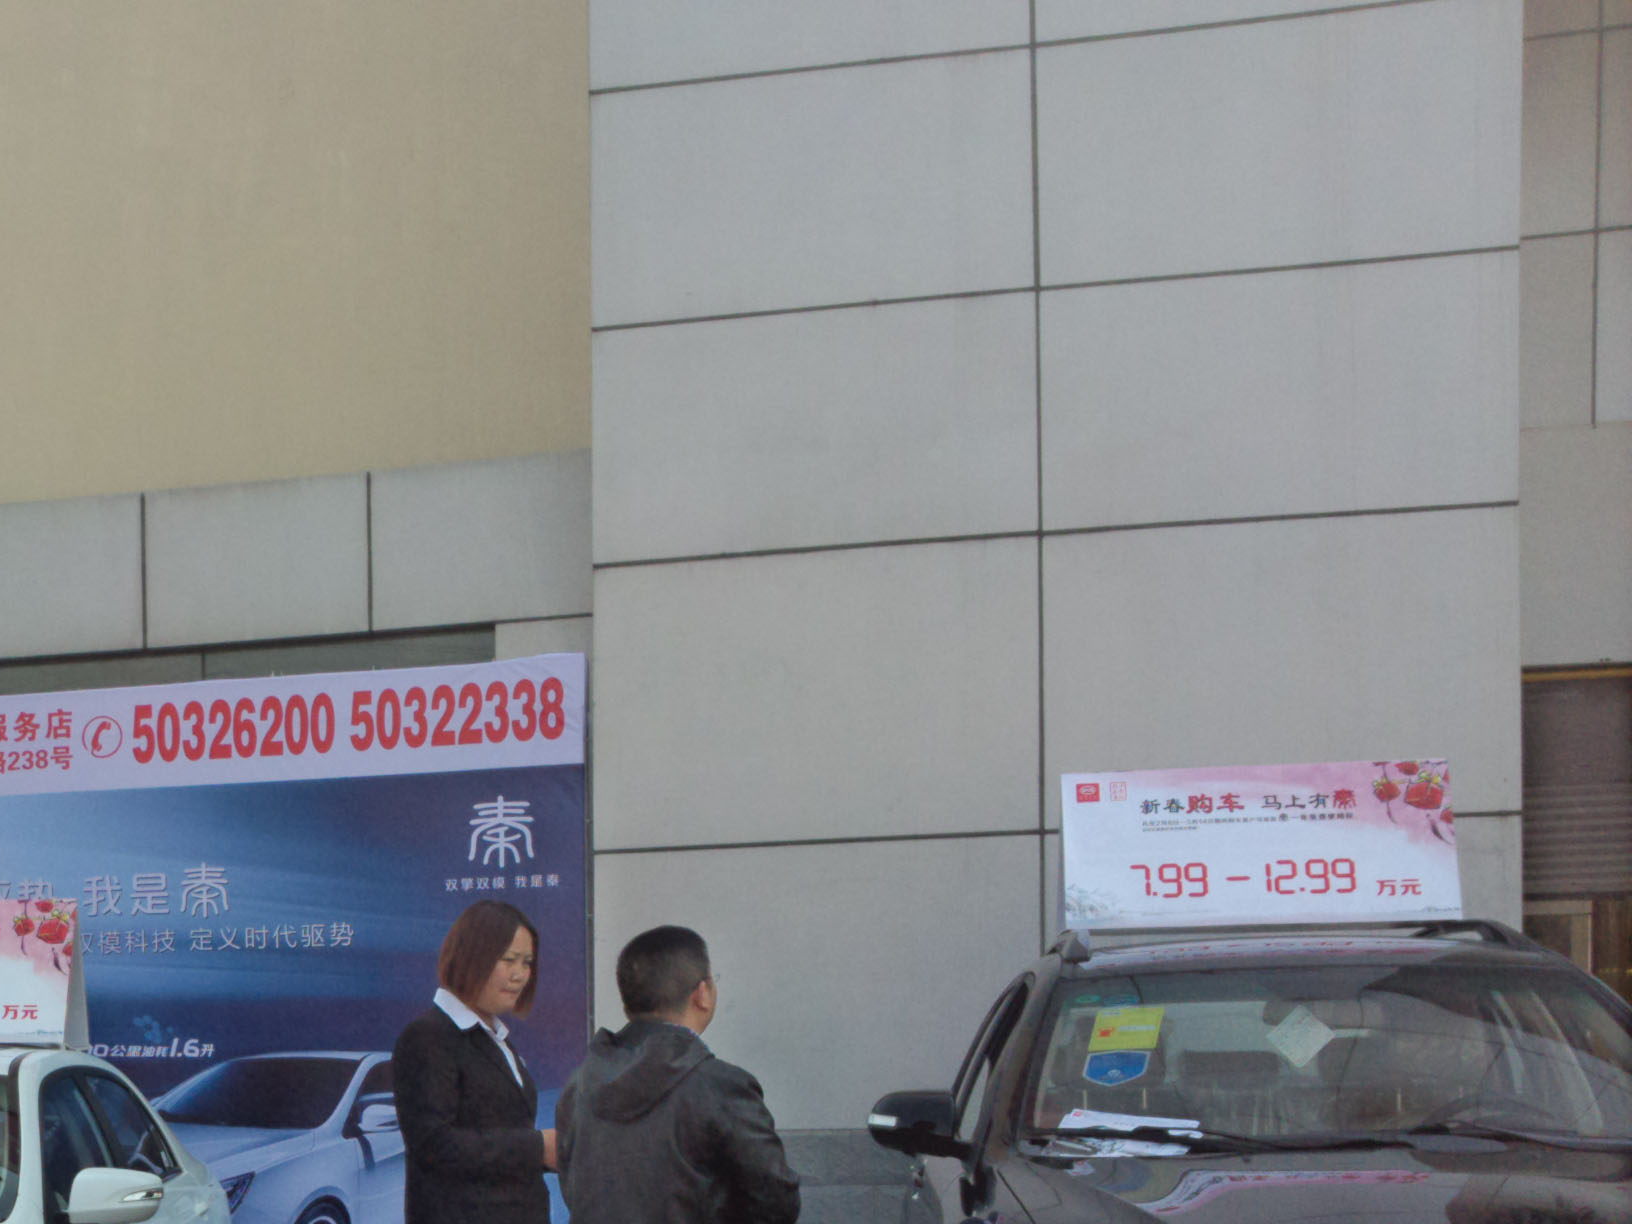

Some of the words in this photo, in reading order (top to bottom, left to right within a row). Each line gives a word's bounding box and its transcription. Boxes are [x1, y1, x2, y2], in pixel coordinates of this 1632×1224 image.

[132, 692, 335, 764] 50326200
[350, 677, 564, 752] 50322338
[1139, 793, 1245, 815] 新春购车
[1130, 861, 1209, 898] 7.99
[1265, 858, 1357, 895] 12.99
[1375, 879, 1422, 897] 万元
[189, 921, 355, 952] 定义时代驱势
[1, 1005, 40, 1020] 万元
